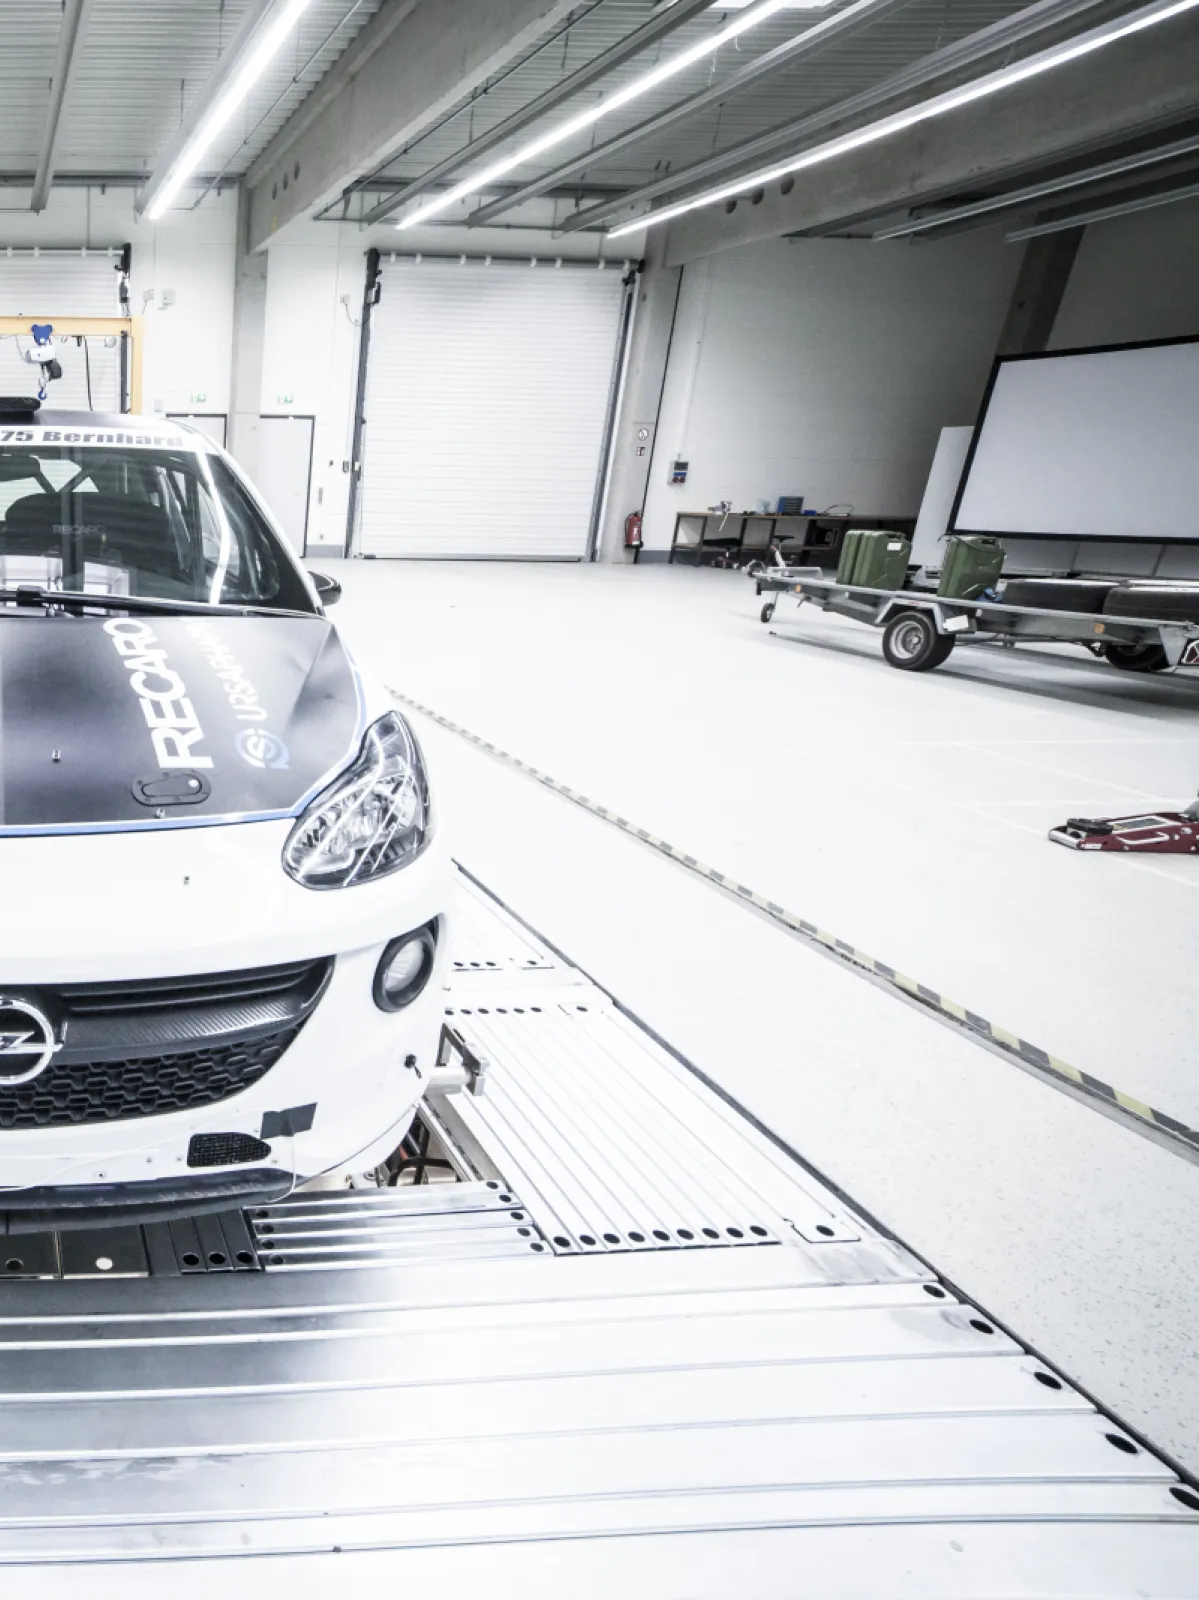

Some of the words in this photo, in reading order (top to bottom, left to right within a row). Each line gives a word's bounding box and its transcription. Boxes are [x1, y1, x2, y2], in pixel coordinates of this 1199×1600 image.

[0, 429, 35, 442] 75
[42, 430, 184, 447] Bernhard
[102, 617, 215, 769] RECARO
